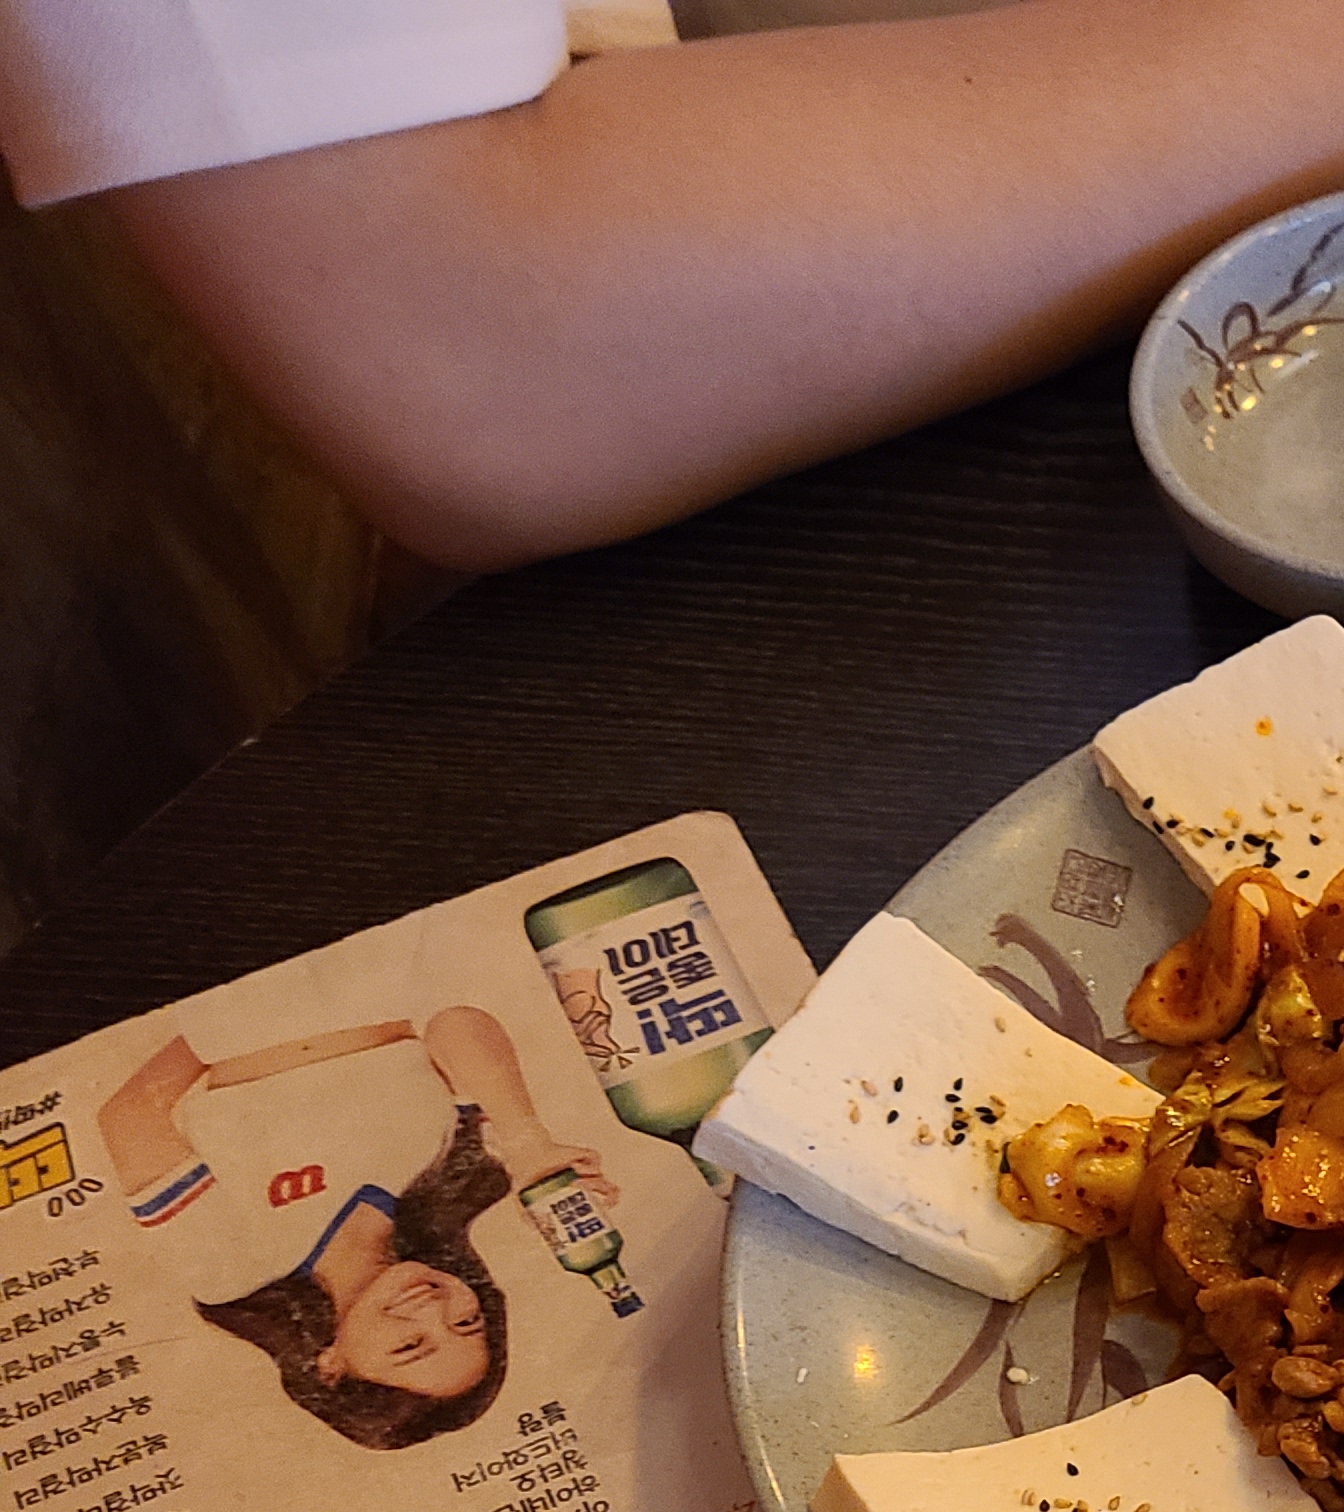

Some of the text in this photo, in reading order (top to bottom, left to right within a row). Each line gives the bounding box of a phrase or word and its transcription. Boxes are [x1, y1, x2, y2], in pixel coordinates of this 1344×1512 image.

[601, 919, 701, 977] 데이
[616, 950, 717, 1007] 좋은
[636, 989, 743, 1057] 딱!
[0, 1249, 100, 1303] 부천막걸
[0, 1320, 126, 1386] 누룽지막걸
[1, 1394, 152, 1471] 옥수수막걸리
[517, 1401, 566, 1437] 블랑
[12, 1433, 169, 1510] 복분자막걸리
[450, 1428, 578, 1493] 버드와이저
[508, 1448, 588, 1493] 칭타오
